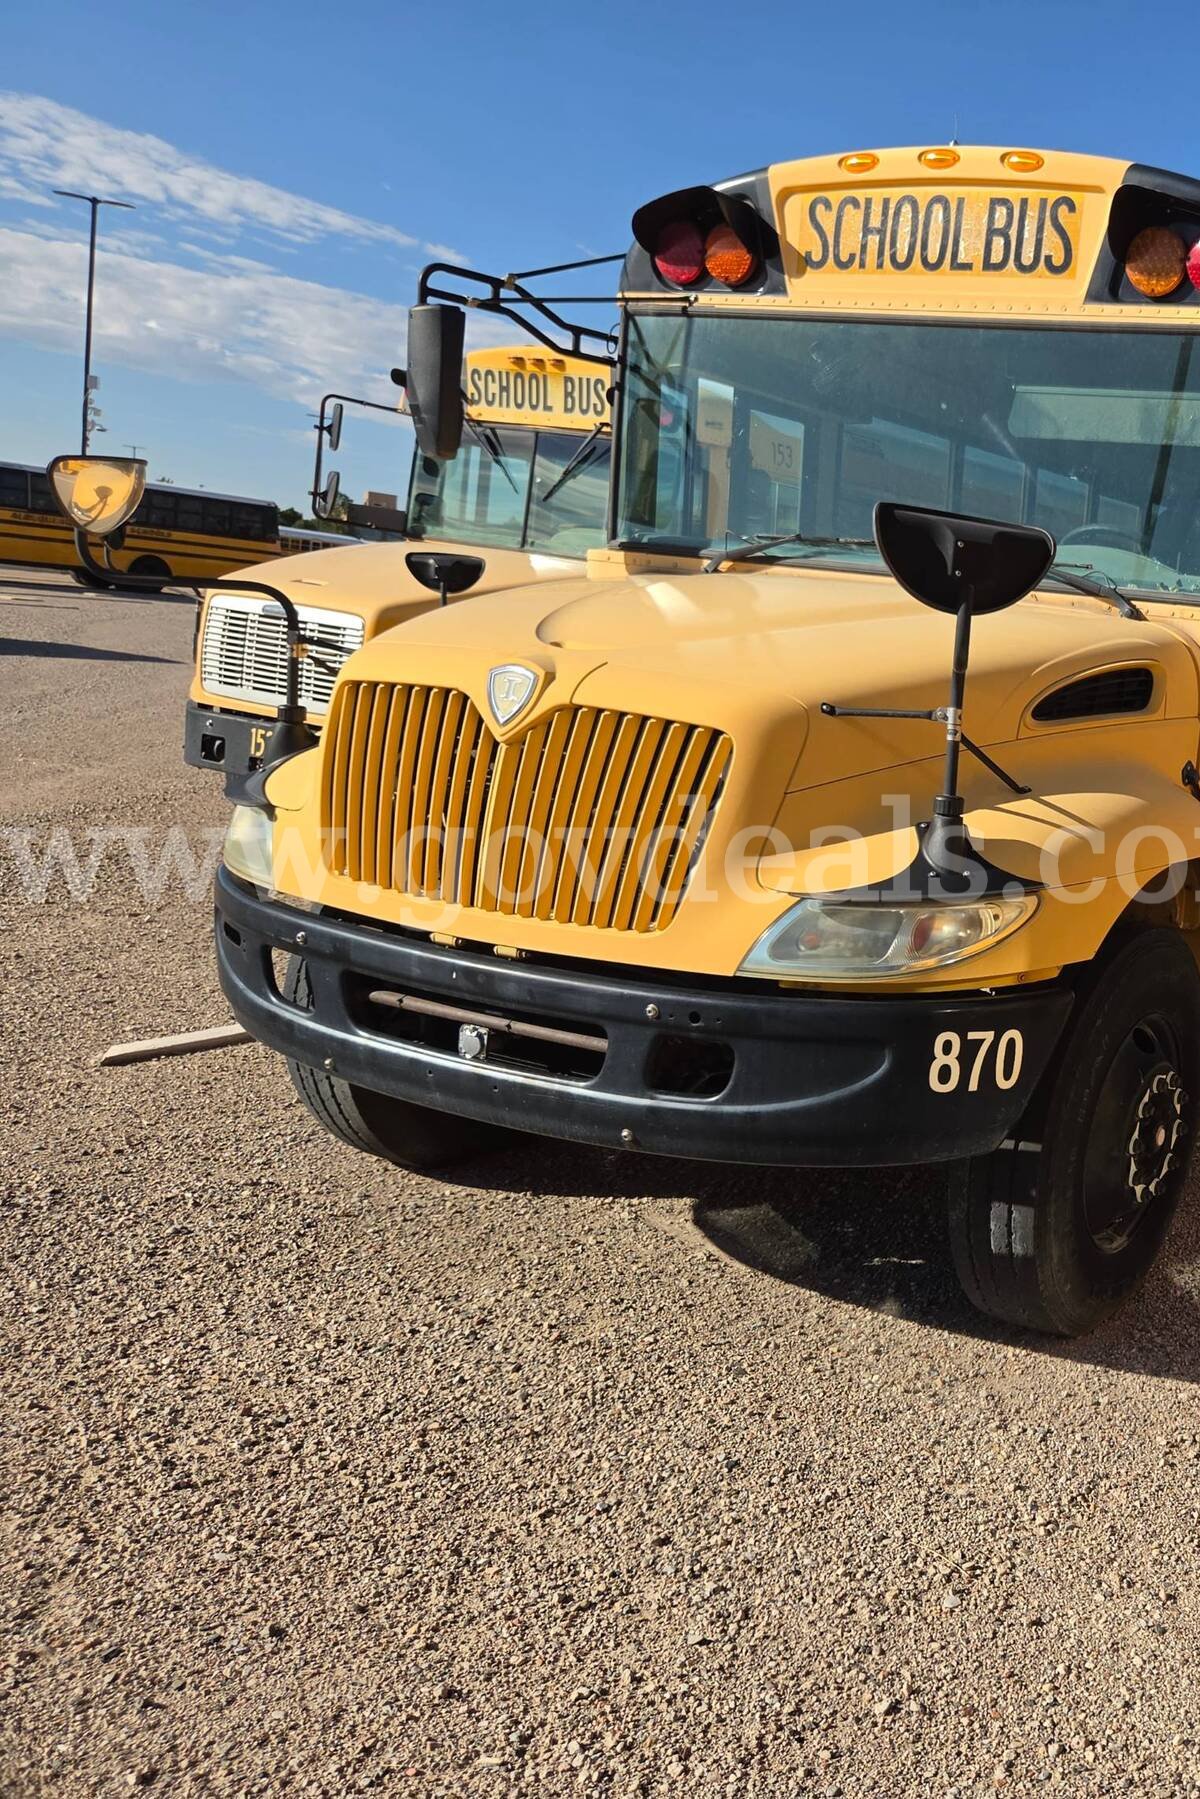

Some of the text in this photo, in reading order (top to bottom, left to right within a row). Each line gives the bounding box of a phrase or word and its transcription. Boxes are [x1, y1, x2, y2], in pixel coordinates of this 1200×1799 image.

[804, 194, 1077, 275] SCHOOL BUS
[470, 368, 606, 417] SCHOOL BUS
[771, 441, 793, 469] 153
[251, 727, 273, 758] 15
[927, 1028, 1024, 1094] 870
